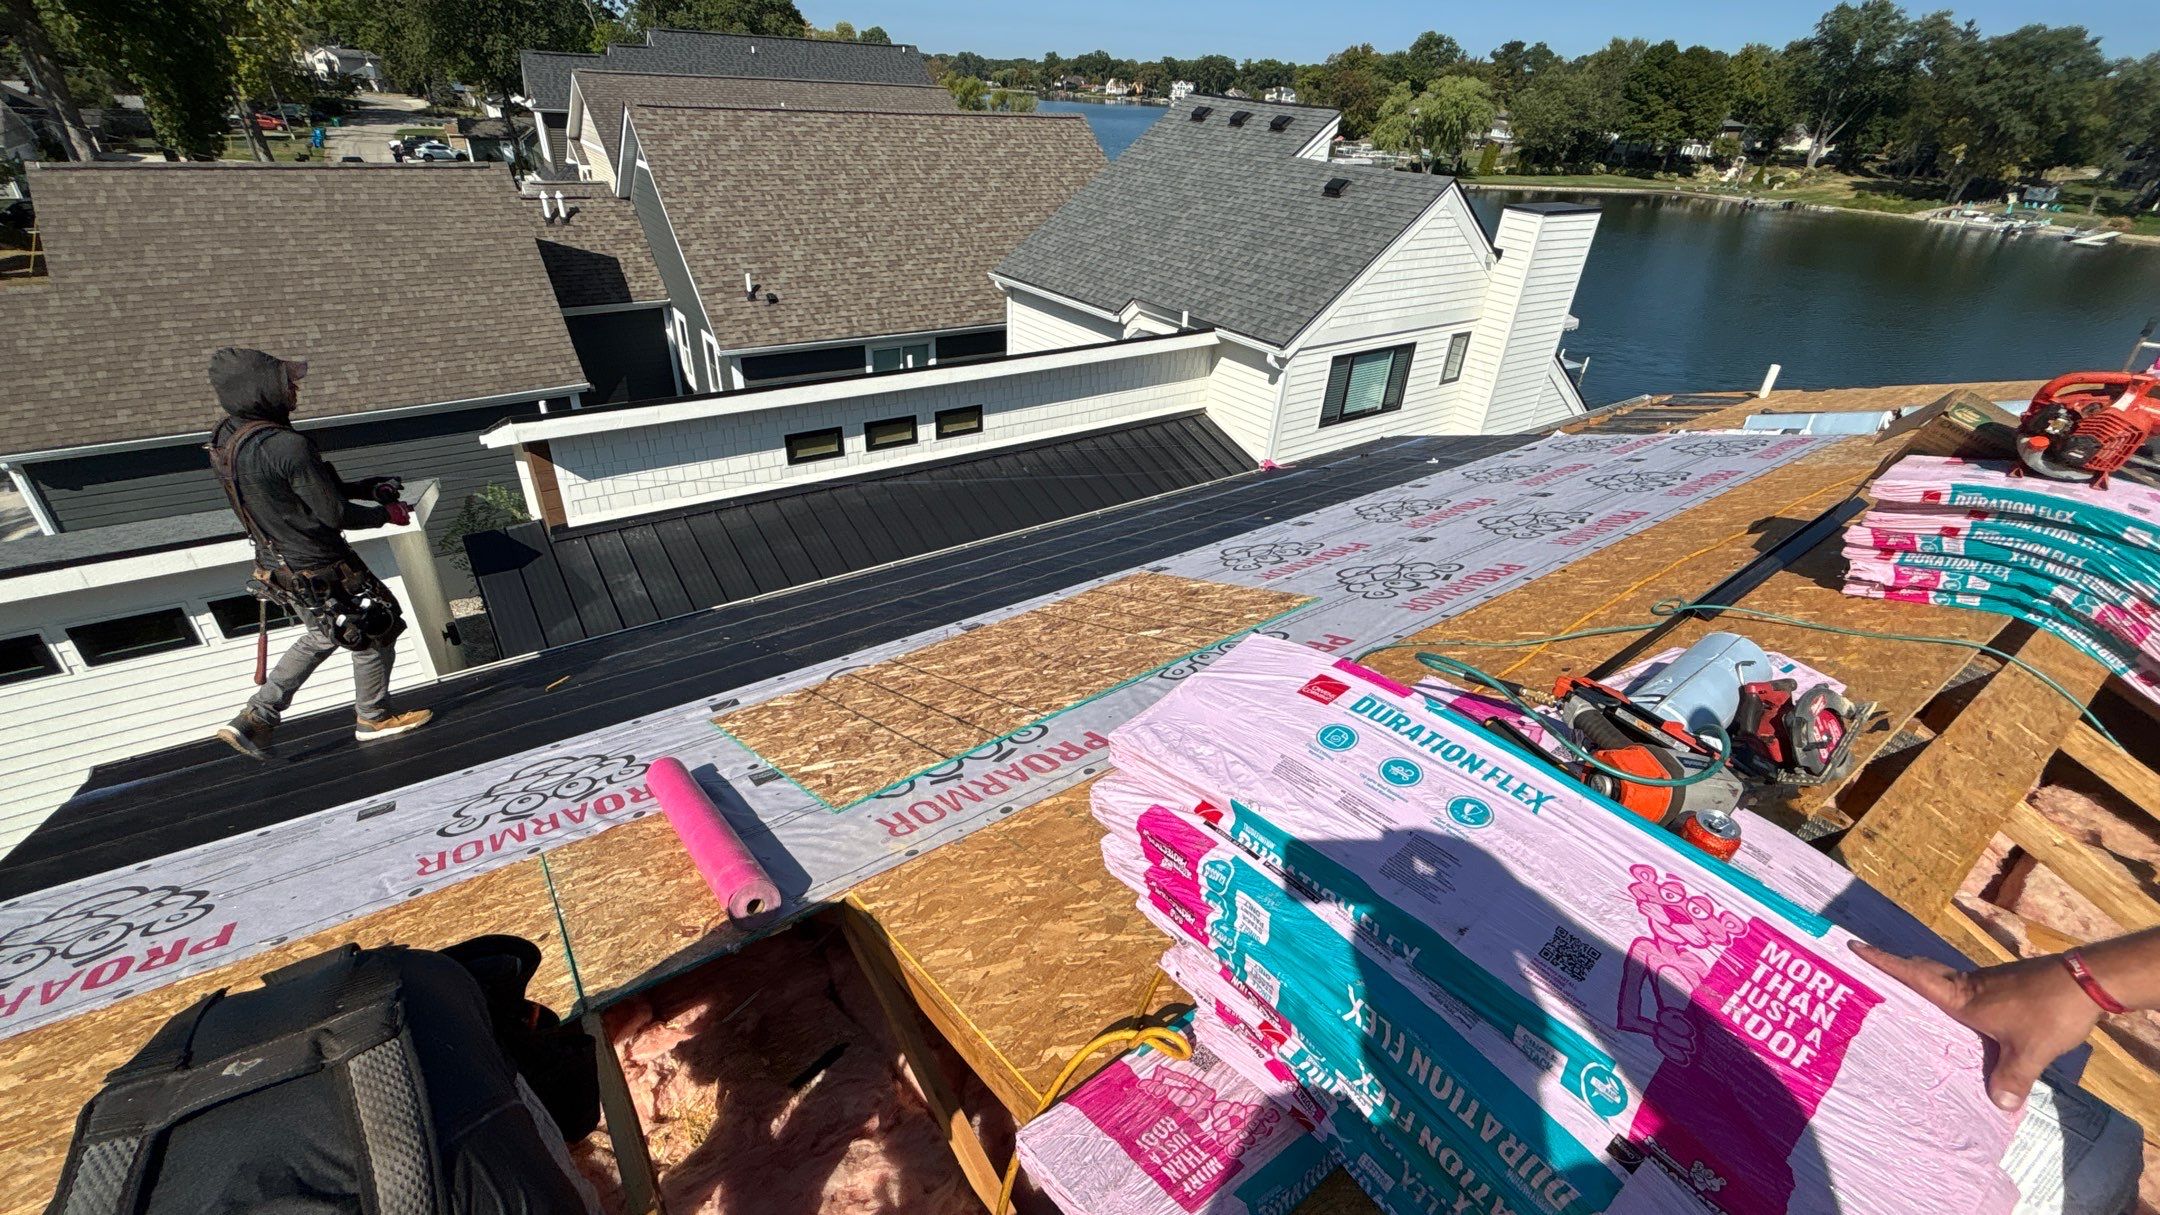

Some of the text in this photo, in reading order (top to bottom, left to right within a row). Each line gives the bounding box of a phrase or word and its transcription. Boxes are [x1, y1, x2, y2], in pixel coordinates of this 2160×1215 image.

[1396, 562, 1527, 613] PROARMOR
[875, 731, 1110, 837] PROARMOR
[1350, 695, 1486, 774] DURATION
[1481, 763, 1556, 815] FLEX
[416, 783, 656, 877] ROARMOR
[1751, 959, 1837, 1031] THAN
[1760, 940, 1855, 1011] MORE
[1342, 984, 1406, 1063] FLEX
[1522, 1033, 1558, 1061] SINGLE
[1720, 993, 1817, 1068] ROOF
[1734, 980, 1822, 1050] JUST A
[1352, 1058, 1416, 1134] FLEX
[1407, 1046, 1583, 1212] DURATION
[1161, 1145, 1210, 1184] THAN
